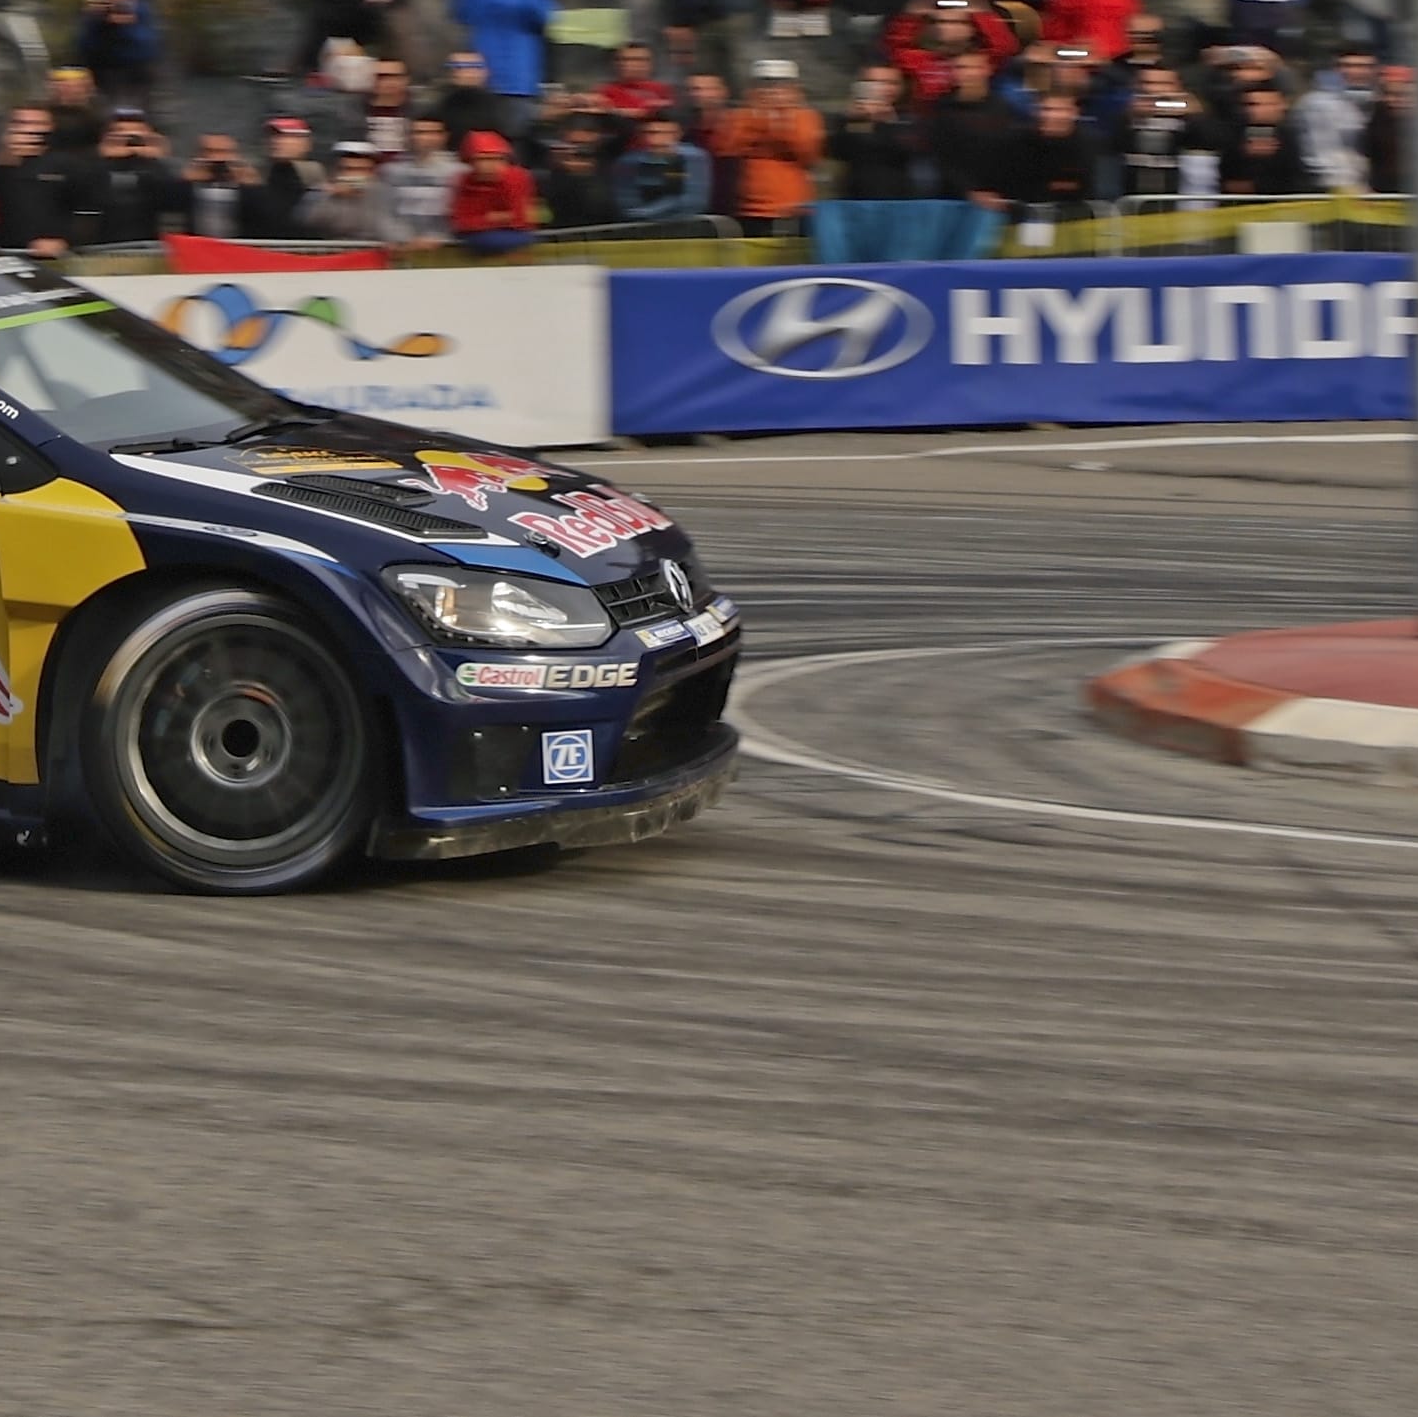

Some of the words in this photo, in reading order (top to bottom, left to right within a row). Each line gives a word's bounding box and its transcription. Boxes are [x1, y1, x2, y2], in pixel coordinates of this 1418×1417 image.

[479, 666, 541, 686] Castrol
[546, 661, 640, 689] EDGE
[551, 743, 586, 772] ZF
